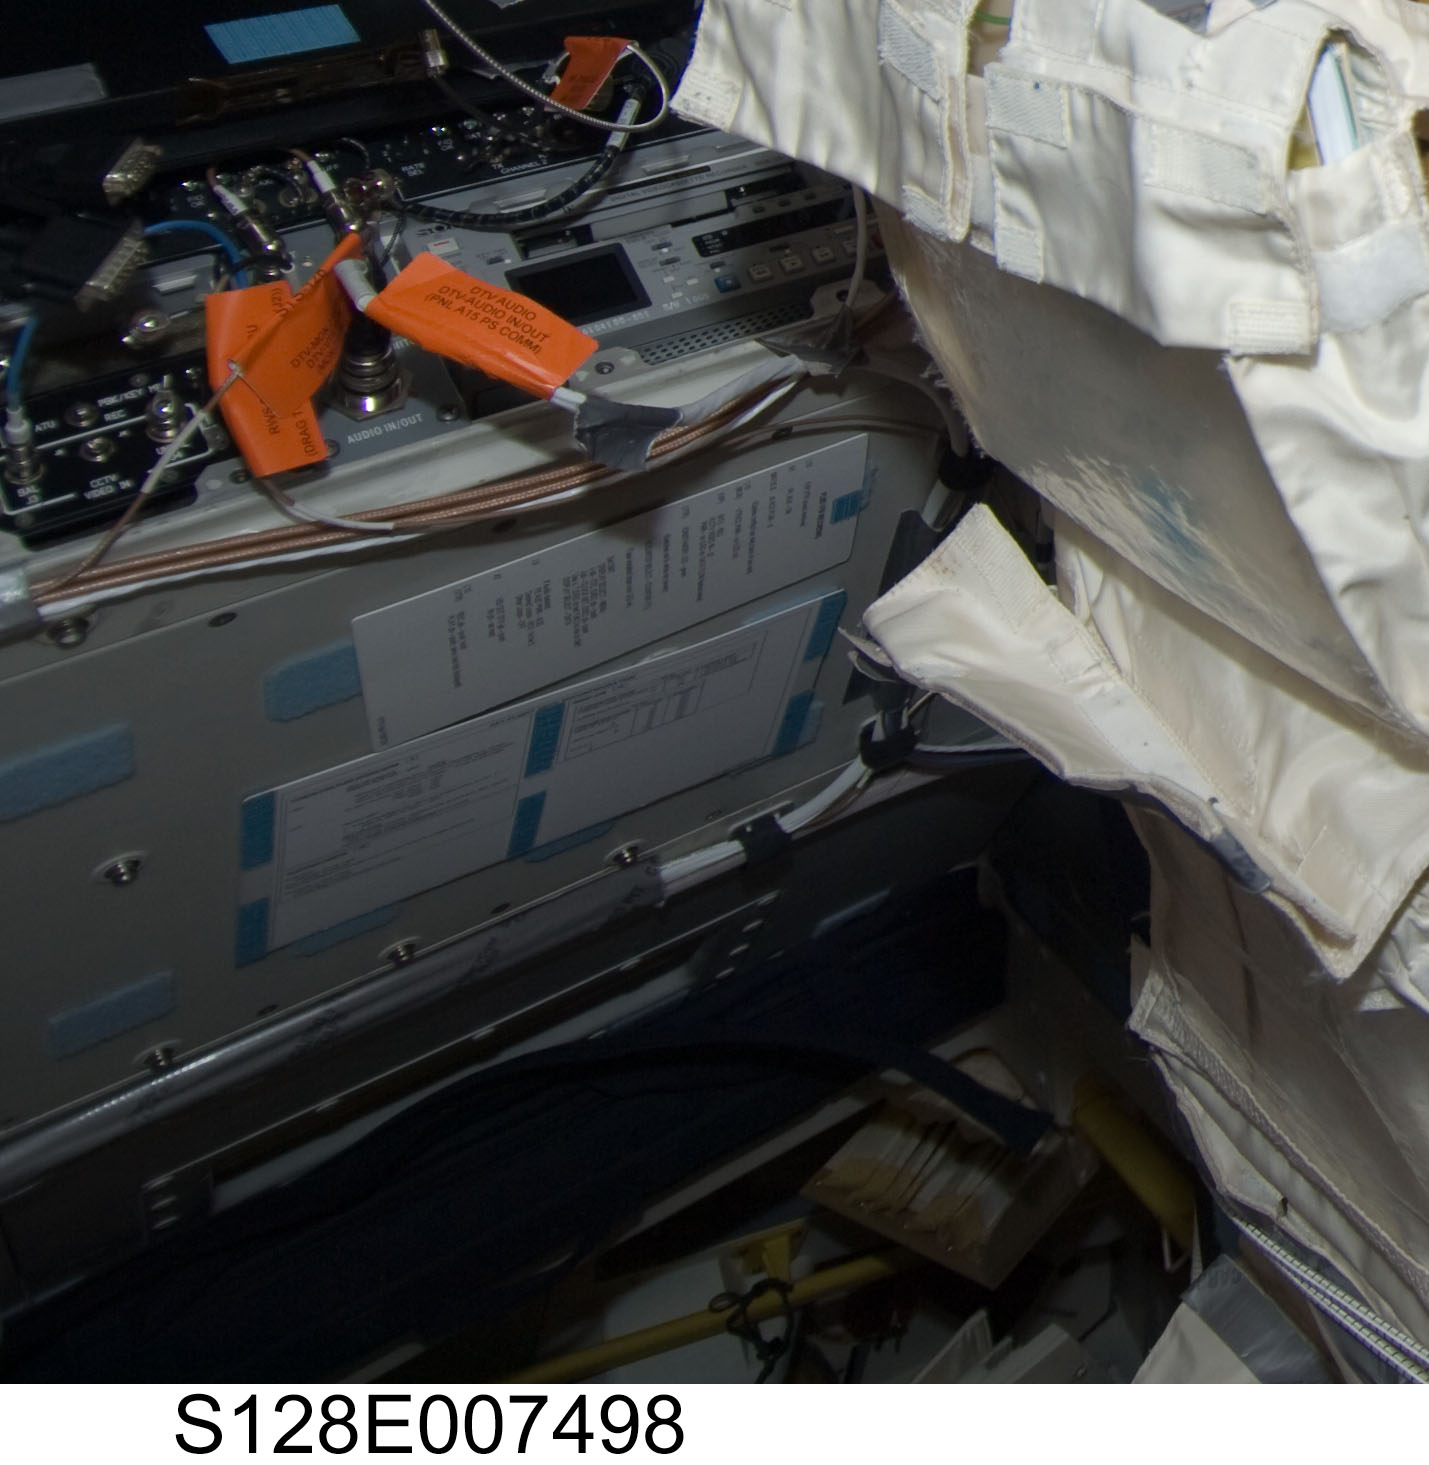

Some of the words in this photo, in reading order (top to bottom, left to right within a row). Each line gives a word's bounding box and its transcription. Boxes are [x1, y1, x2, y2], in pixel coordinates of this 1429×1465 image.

[437, 285, 506, 322] DTV-AUDIO
[502, 313, 550, 341] IN/OUT
[469, 286, 498, 304] DTV
[496, 297, 537, 321] AUDIO
[424, 292, 456, 315] (PNL
[455, 305, 480, 324] A15
[498, 325, 543, 354] COMM)
[104, 409, 127, 421] REC
[347, 423, 383, 444] AUDIO
[385, 413, 423, 434] IN/OUT
[83, 485, 114, 500] VIDEO
